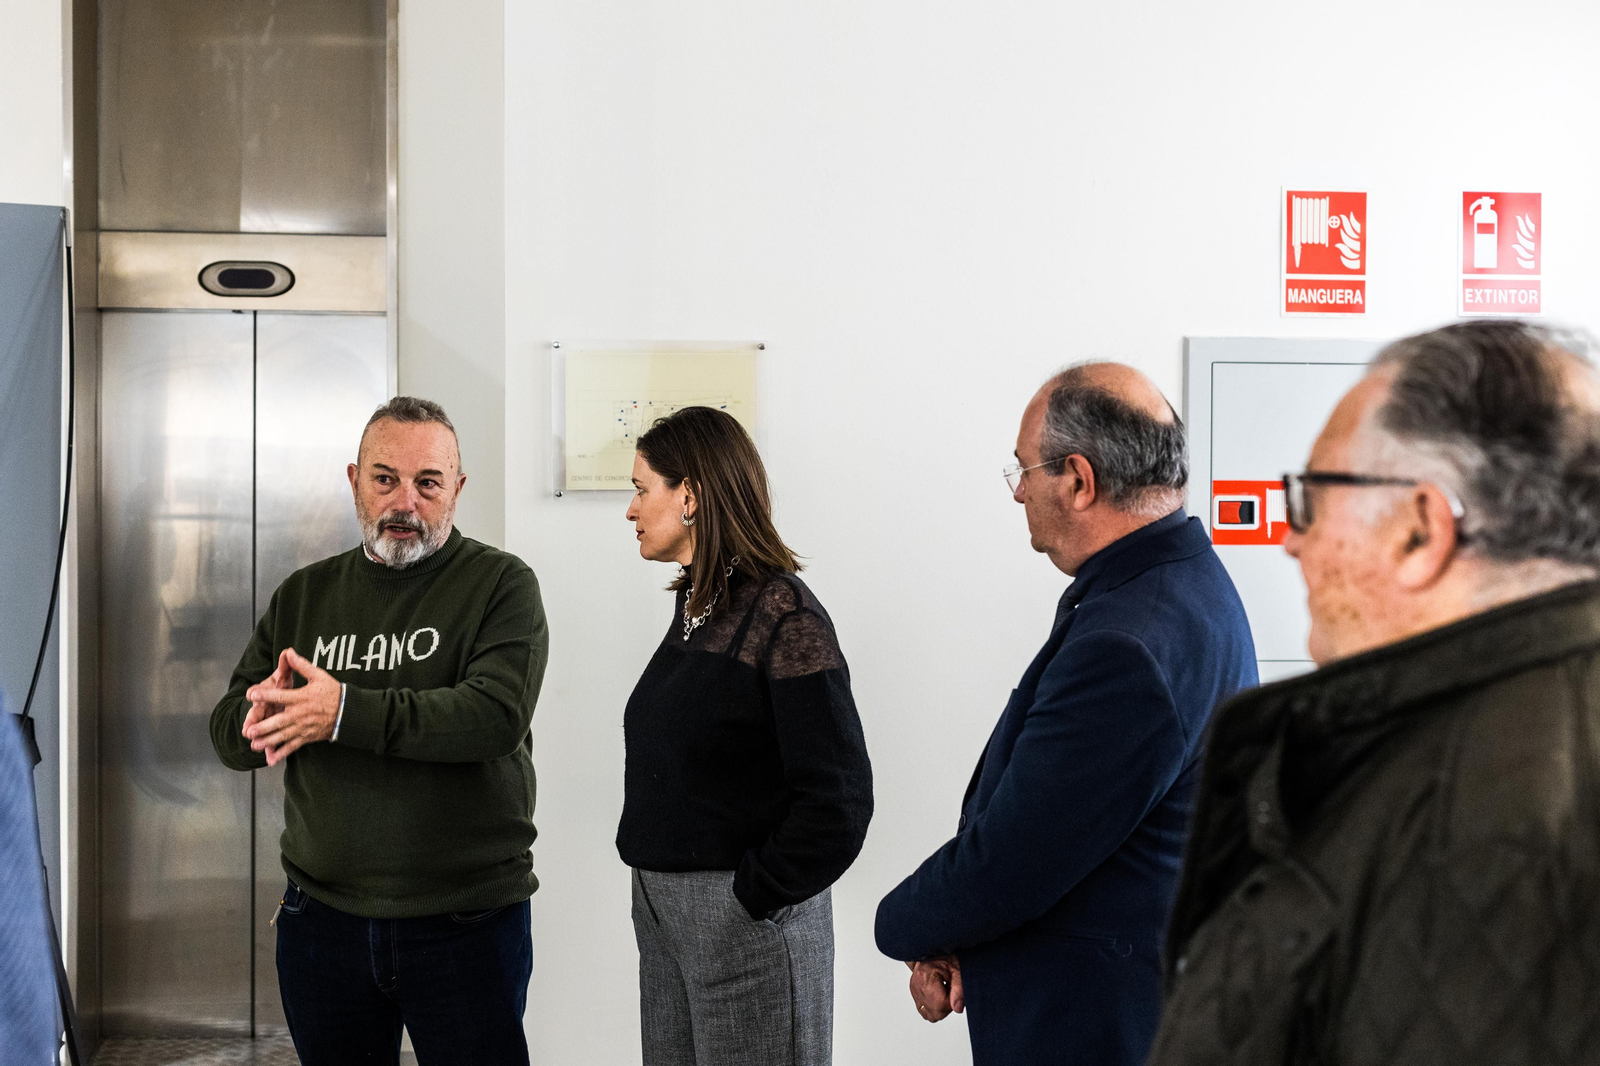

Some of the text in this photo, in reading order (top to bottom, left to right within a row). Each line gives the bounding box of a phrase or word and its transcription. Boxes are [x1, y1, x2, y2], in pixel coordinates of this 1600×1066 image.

[1288, 288, 1363, 305] MANGUERA
[1464, 288, 1538, 304] EXTINTOR
[312, 627, 440, 671] MILANO
